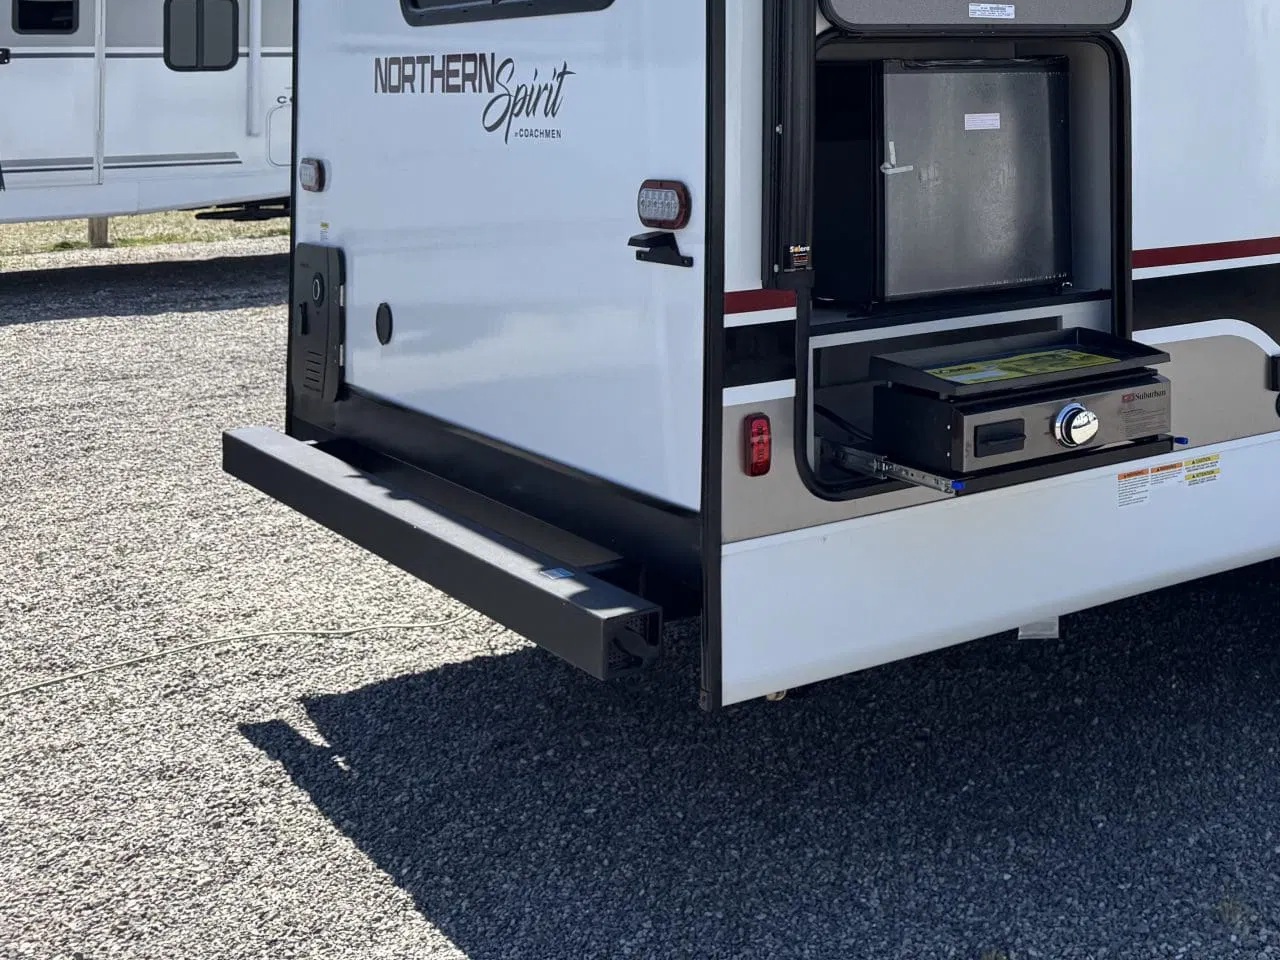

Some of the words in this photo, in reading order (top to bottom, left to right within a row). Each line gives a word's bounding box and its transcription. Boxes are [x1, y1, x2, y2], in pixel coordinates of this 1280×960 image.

[374, 52, 496, 94] NORTHERN
[482, 57, 577, 145] Spirit
[518, 128, 562, 139] COACHMEN
